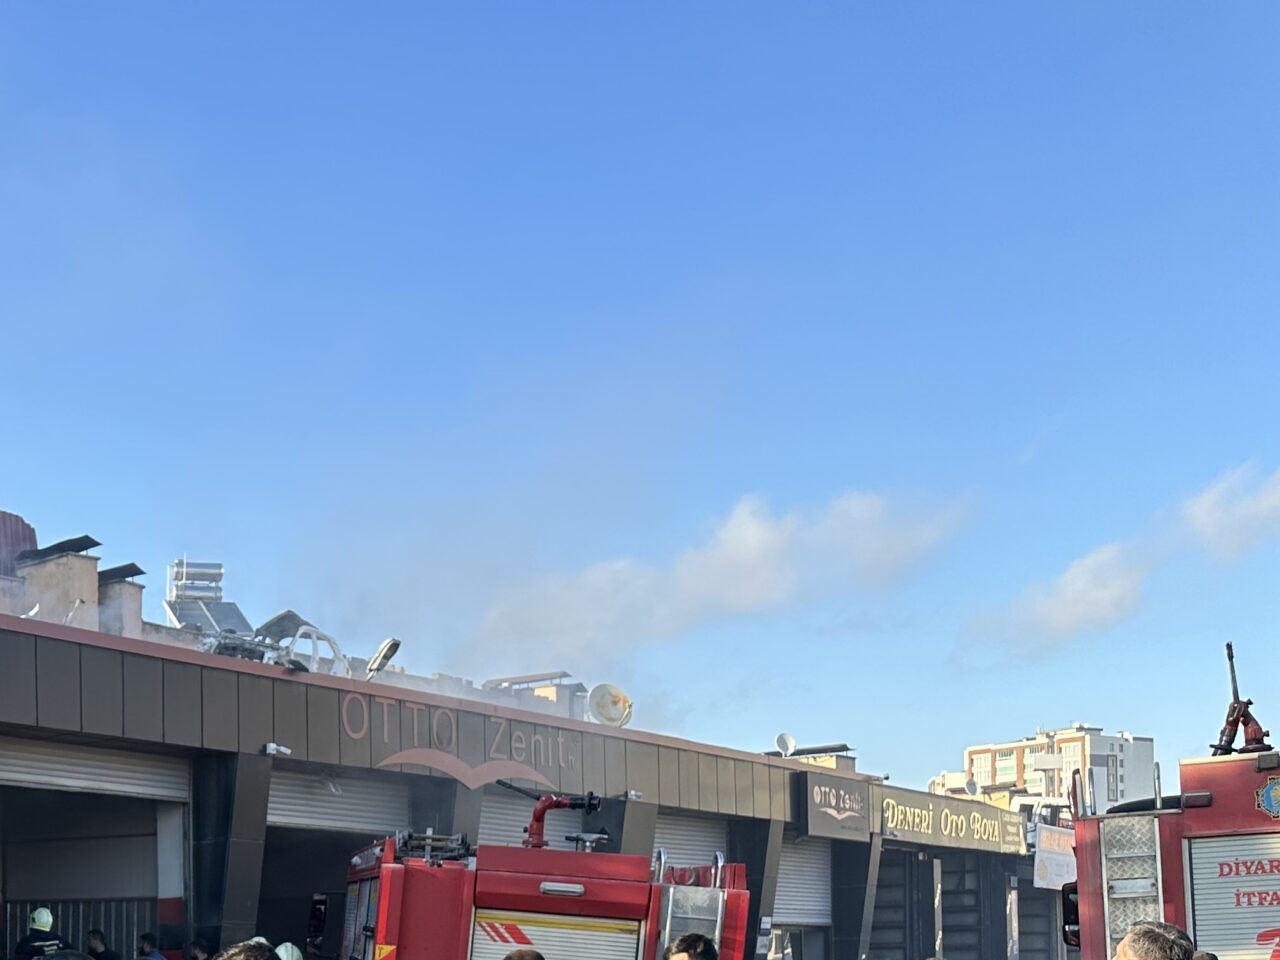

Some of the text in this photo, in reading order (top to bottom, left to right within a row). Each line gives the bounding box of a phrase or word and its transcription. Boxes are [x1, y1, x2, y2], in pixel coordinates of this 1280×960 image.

[341, 692, 457, 750] OTTO
[813, 785, 837, 807] OTTO
[883, 798, 933, 834] DENERİ
[941, 808, 966, 839] OTO
[970, 811, 1000, 842] BOYA
